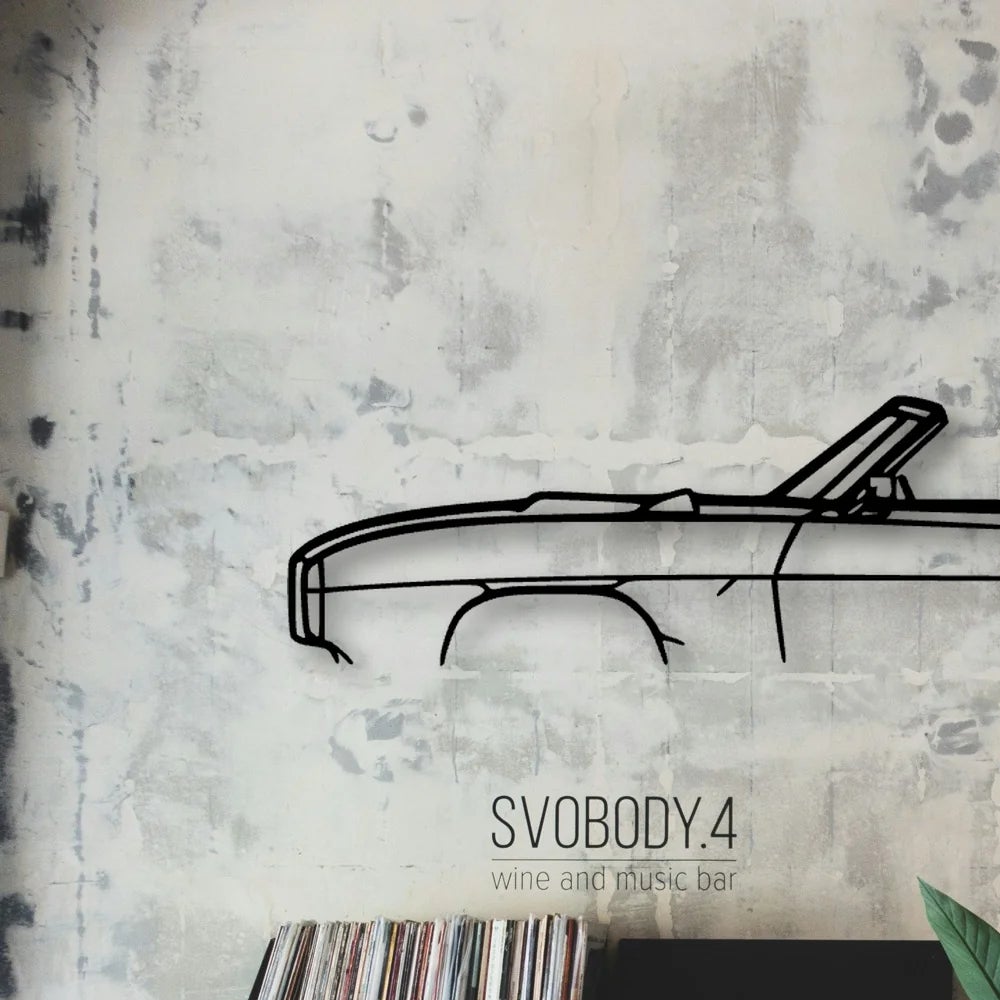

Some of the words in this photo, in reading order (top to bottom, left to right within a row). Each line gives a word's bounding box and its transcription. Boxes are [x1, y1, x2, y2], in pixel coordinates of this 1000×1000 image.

[491, 795, 738, 849] SVOBODY.4
[491, 866, 551, 891] wine
[560, 865, 606, 891] and
[616, 866, 688, 891] music
[697, 865, 738, 891] bar
